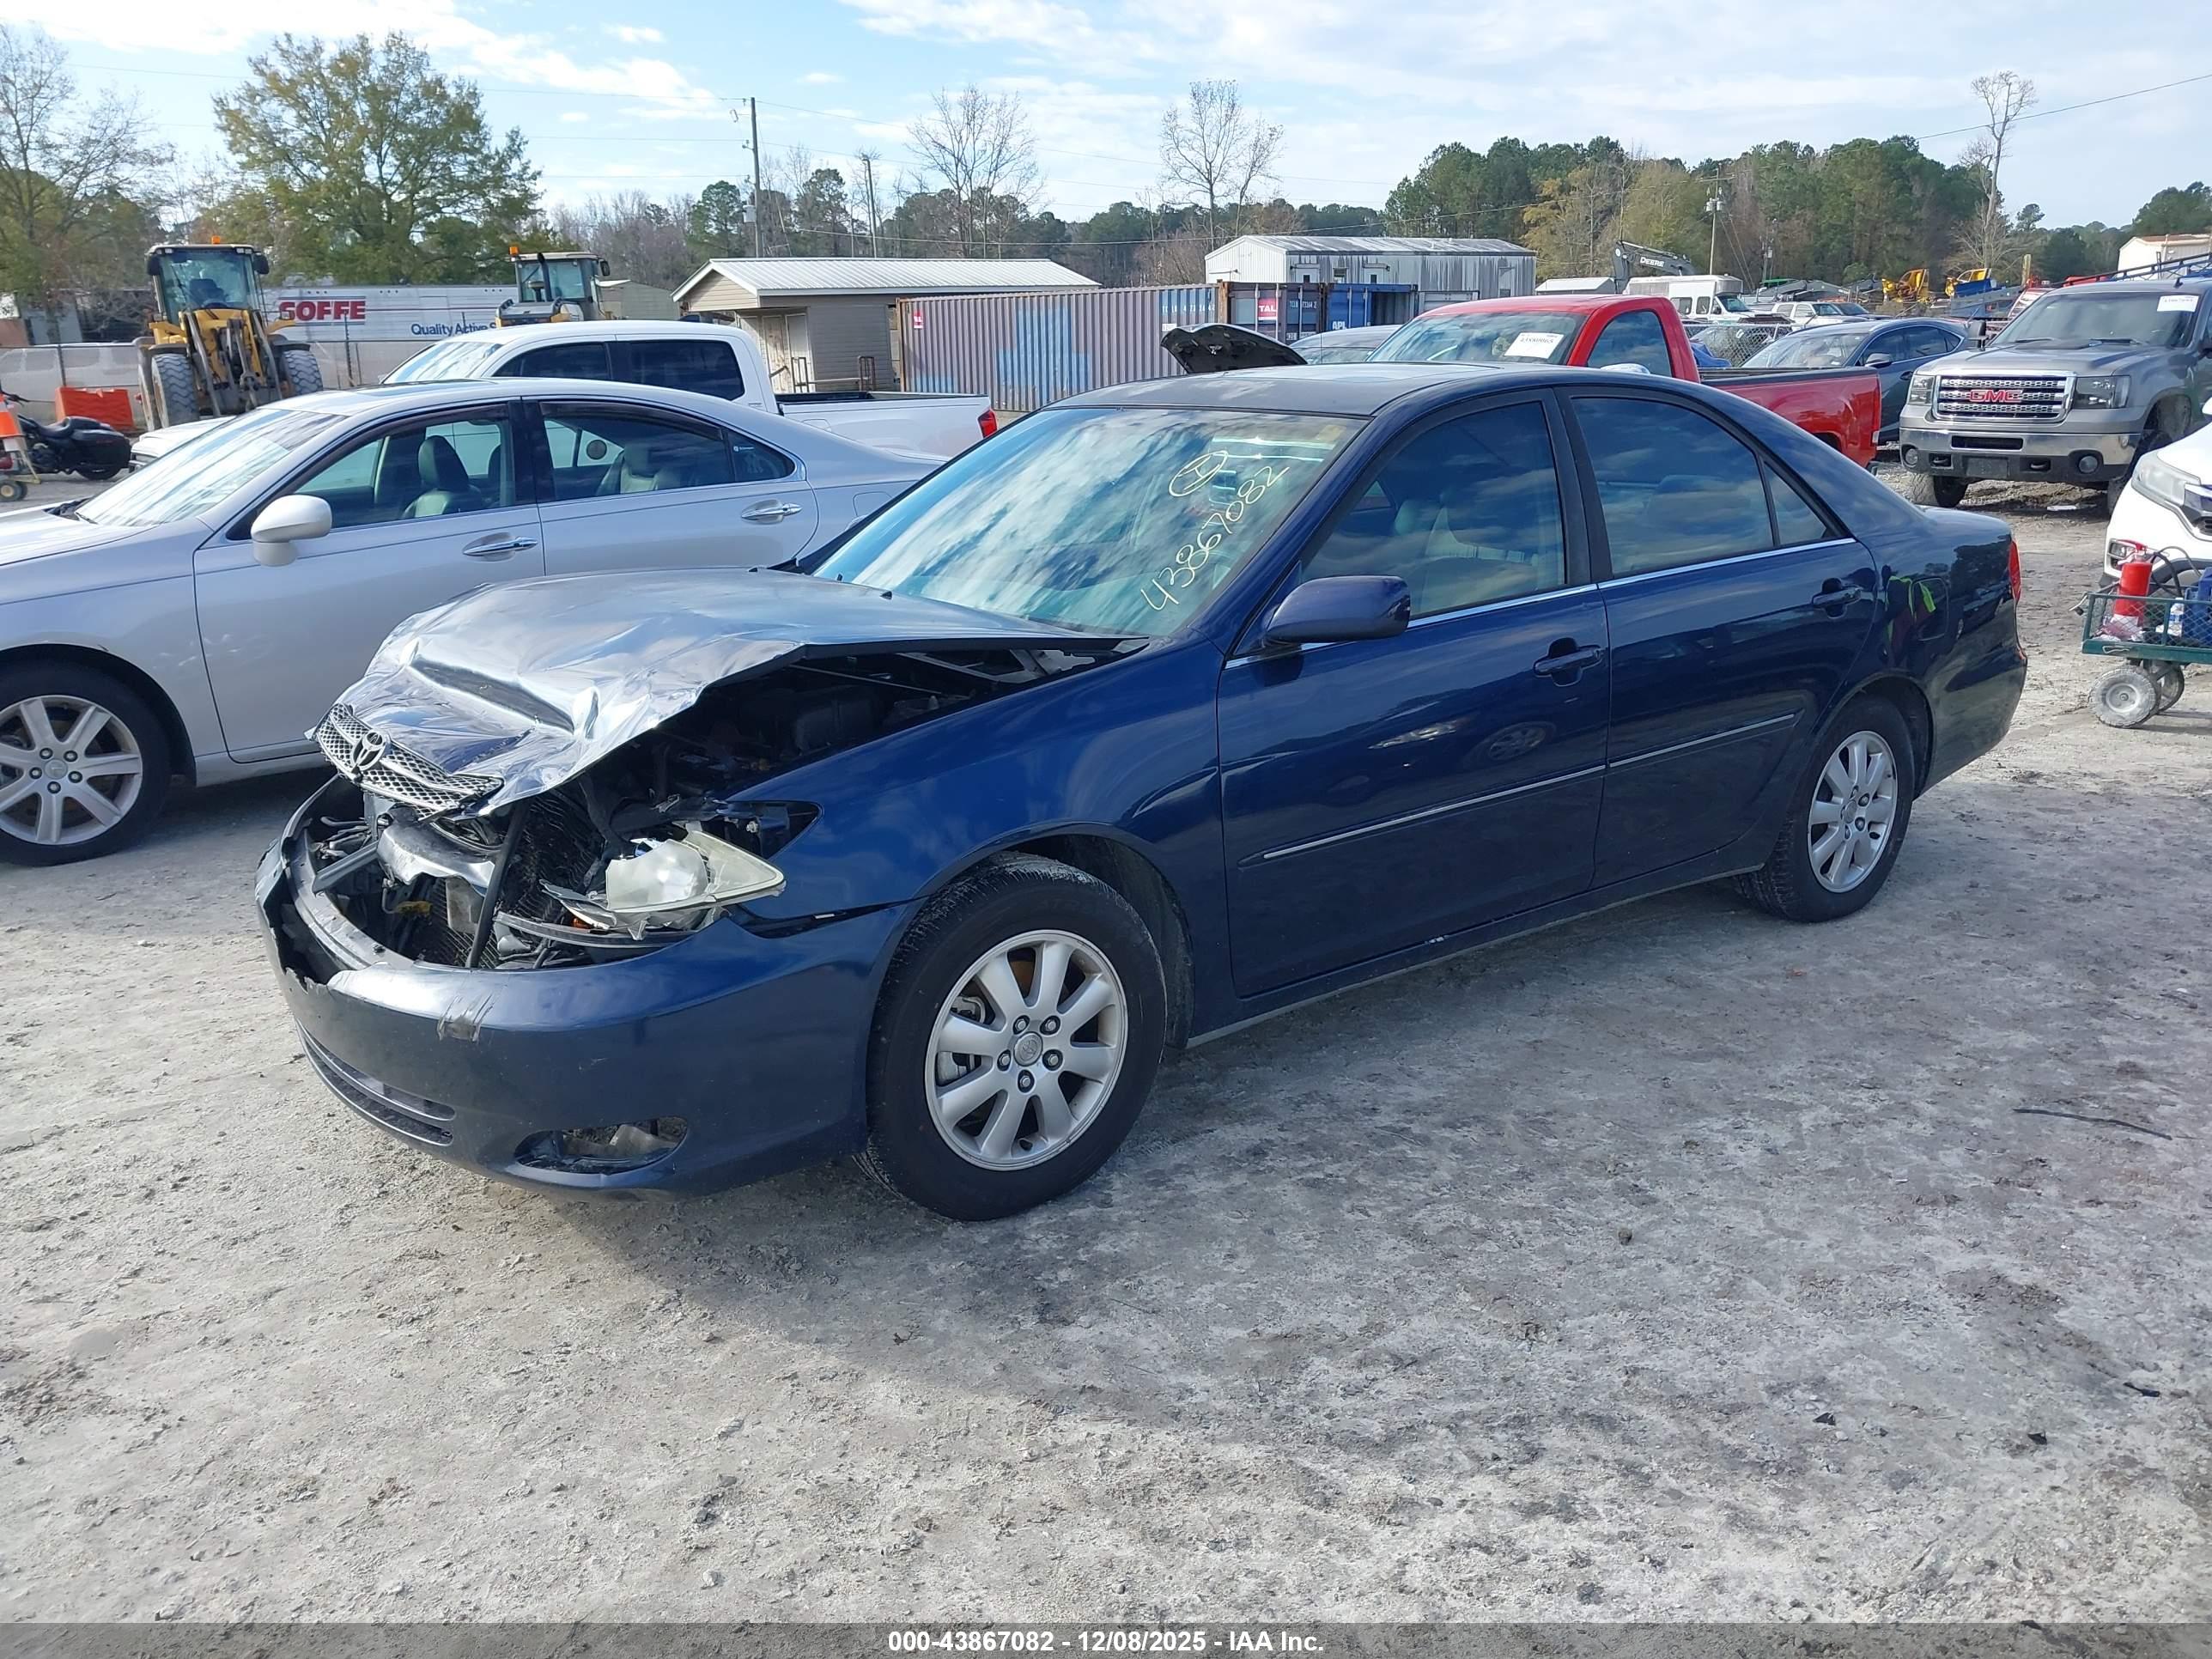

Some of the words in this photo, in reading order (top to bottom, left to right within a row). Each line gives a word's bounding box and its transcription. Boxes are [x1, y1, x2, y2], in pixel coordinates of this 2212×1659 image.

[1640, 257, 1665, 267] DEERE
[279, 301, 366, 321] SOFFE
[411, 323, 453, 337] Quality
[1970, 389, 2023, 403] GMC
[1140, 465, 1291, 611] 43867082
